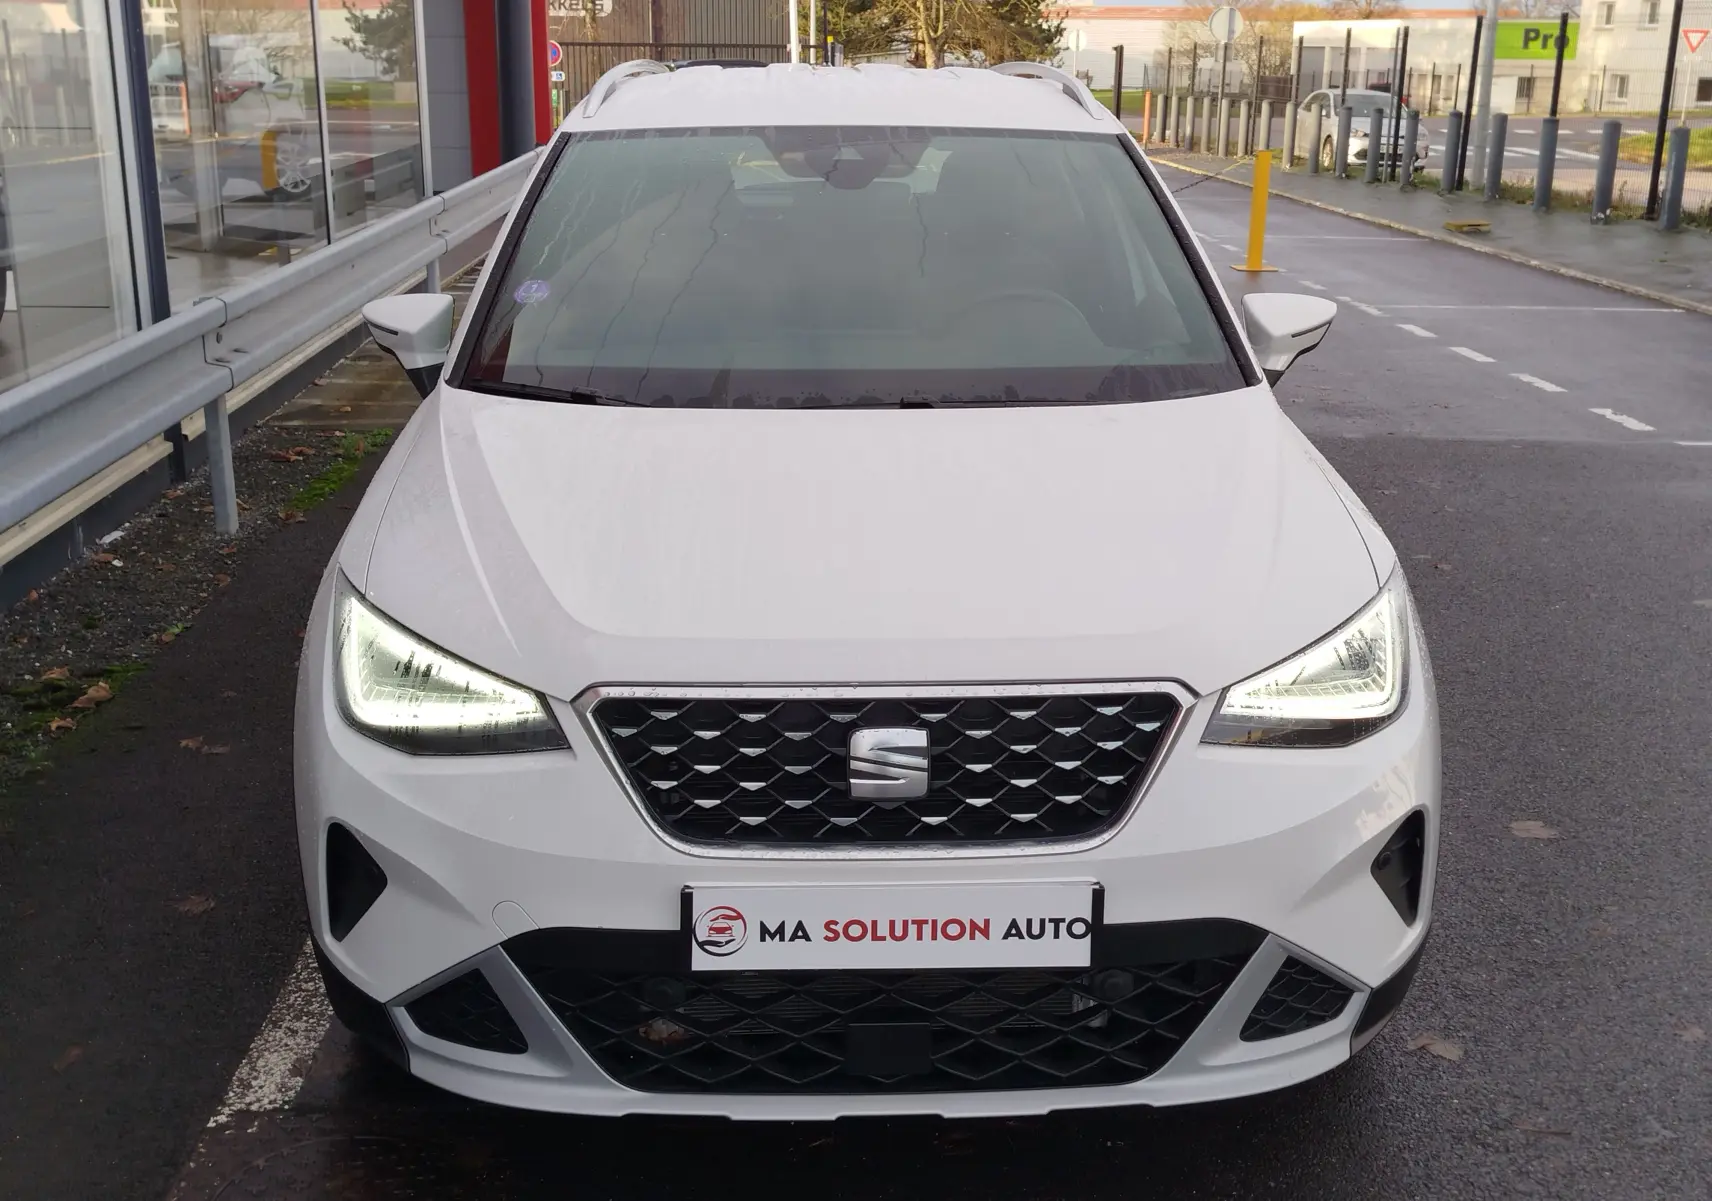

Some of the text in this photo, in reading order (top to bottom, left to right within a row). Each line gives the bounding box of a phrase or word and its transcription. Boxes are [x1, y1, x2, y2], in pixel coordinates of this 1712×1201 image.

[759, 917, 1092, 943] MA SOLUTION AUTO
